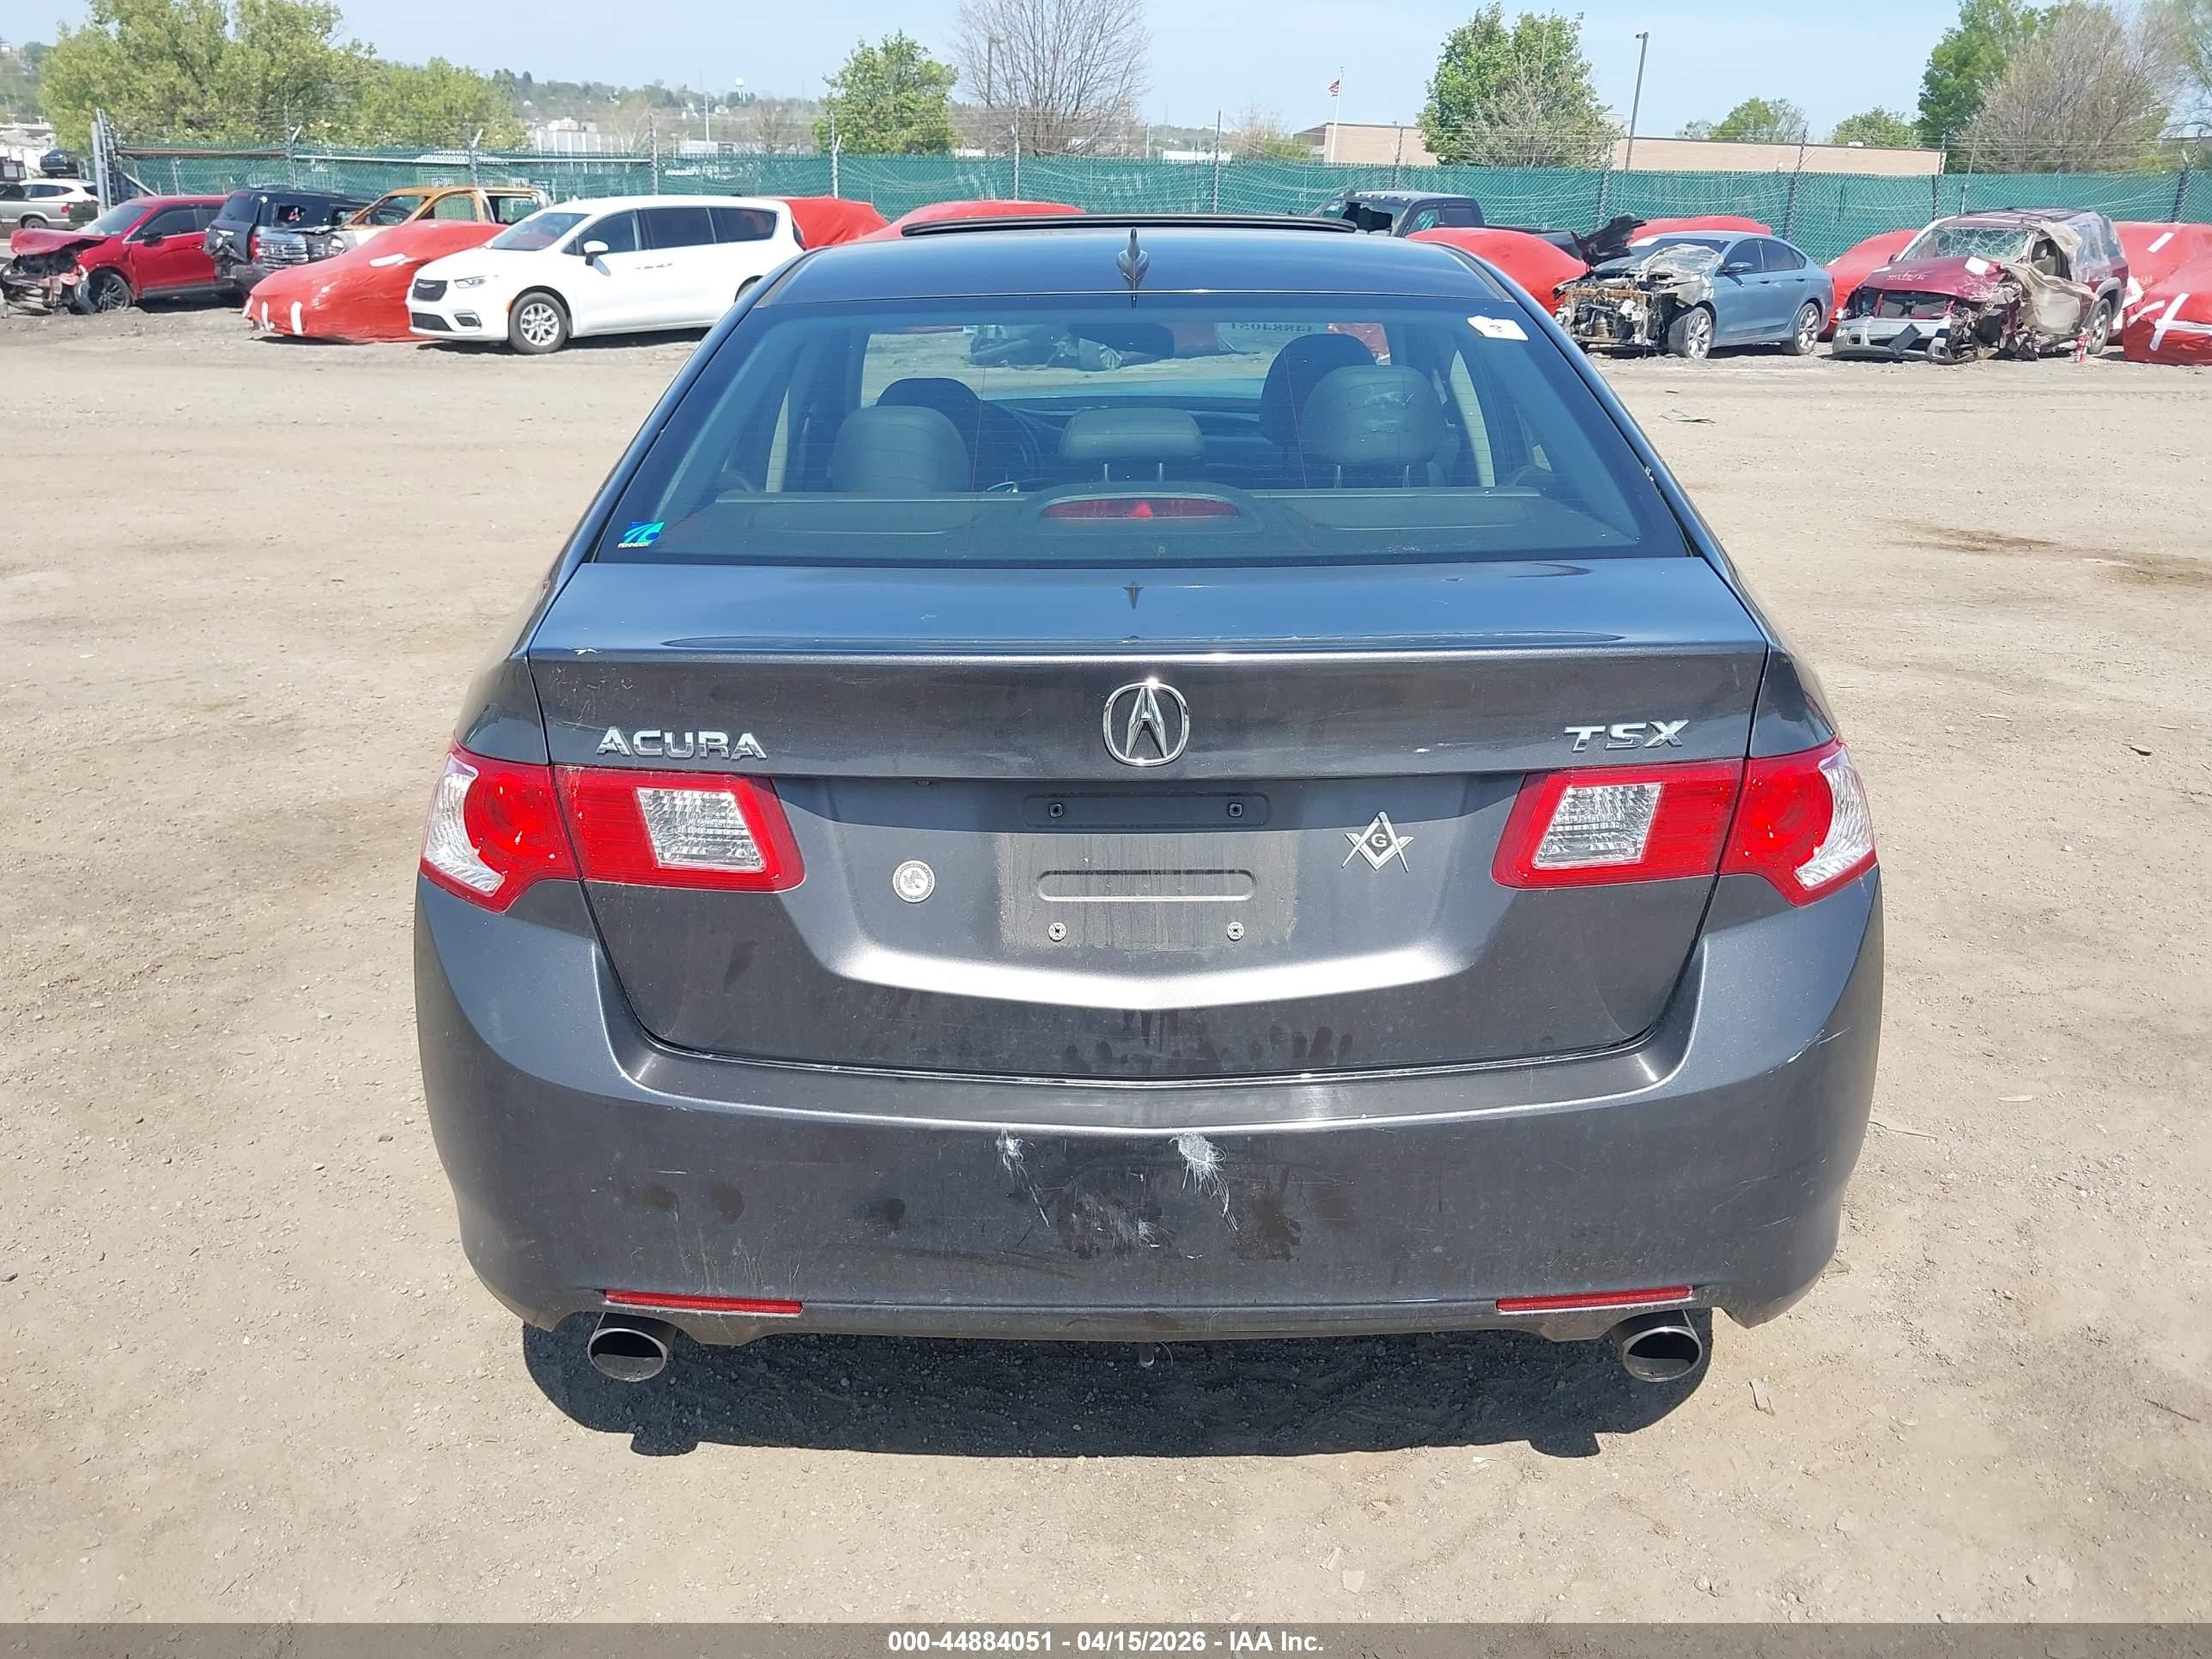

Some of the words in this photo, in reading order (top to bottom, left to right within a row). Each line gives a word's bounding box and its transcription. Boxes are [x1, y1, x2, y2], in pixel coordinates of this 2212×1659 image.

[596, 726, 768, 761] ACURA
[1563, 720, 1689, 753] TSX
[1370, 833, 1388, 848] G
